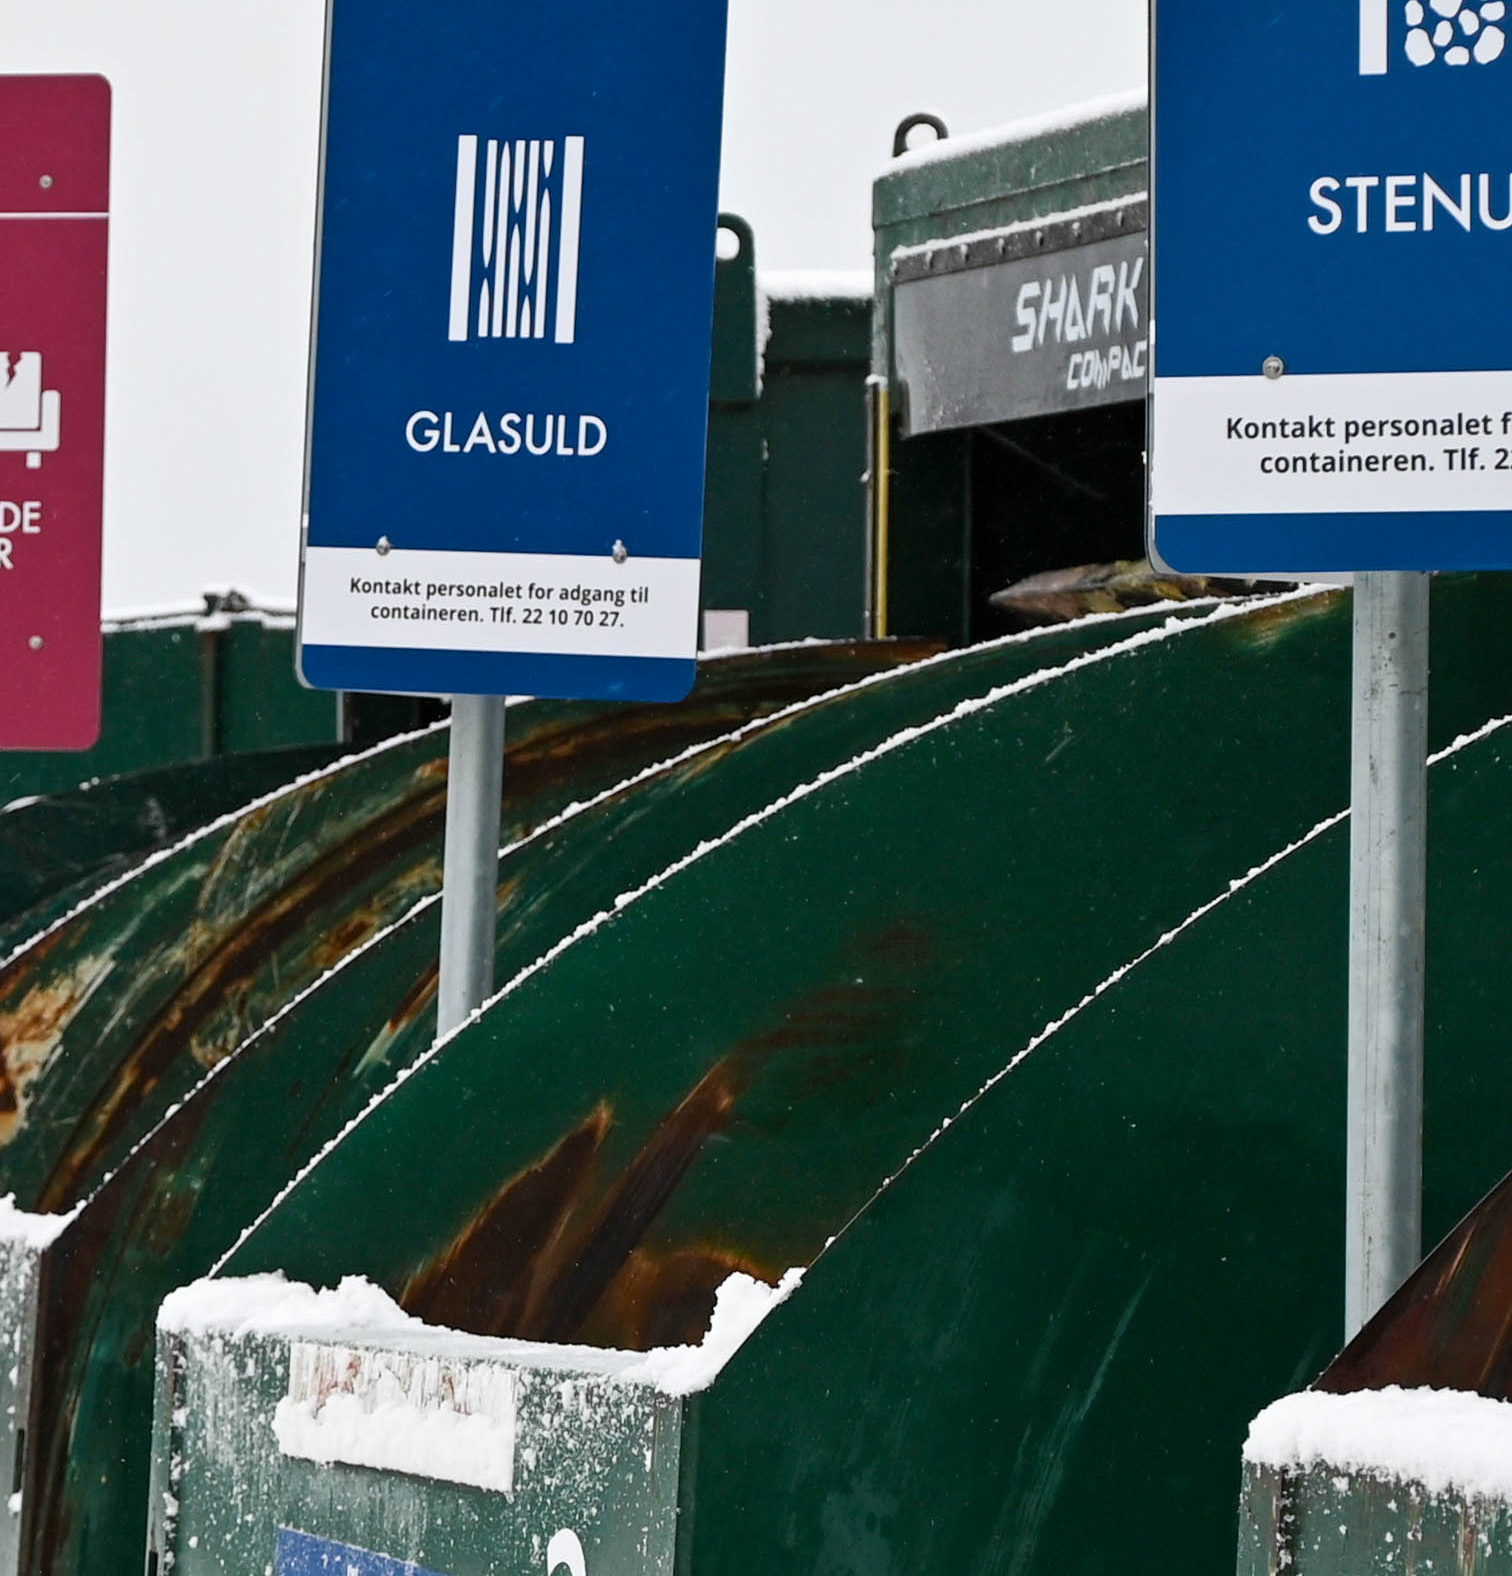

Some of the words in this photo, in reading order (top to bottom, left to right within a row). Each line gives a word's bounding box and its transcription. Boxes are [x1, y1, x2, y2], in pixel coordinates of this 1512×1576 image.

[1012, 257, 1144, 353] SHARK
[406, 411, 606, 455] GLASULD
[1228, 416, 1335, 439] Kontakt
[1345, 413, 1492, 444] personalet
[1261, 450, 1434, 473] containeren.
[1444, 448, 1484, 470] Tlf.
[351, 578, 420, 595] Kontakt
[427, 582, 522, 600] personalet
[529, 583, 553, 599] for
[560, 585, 624, 607] adgang
[631, 587, 648, 602] til
[371, 604, 483, 621] containeren.
[490, 607, 516, 623] Tlf.
[523, 609, 542, 624] 22
[550, 610, 568, 625] 10
[574, 610, 593, 626] 70
[599, 611, 623, 627] 27.
